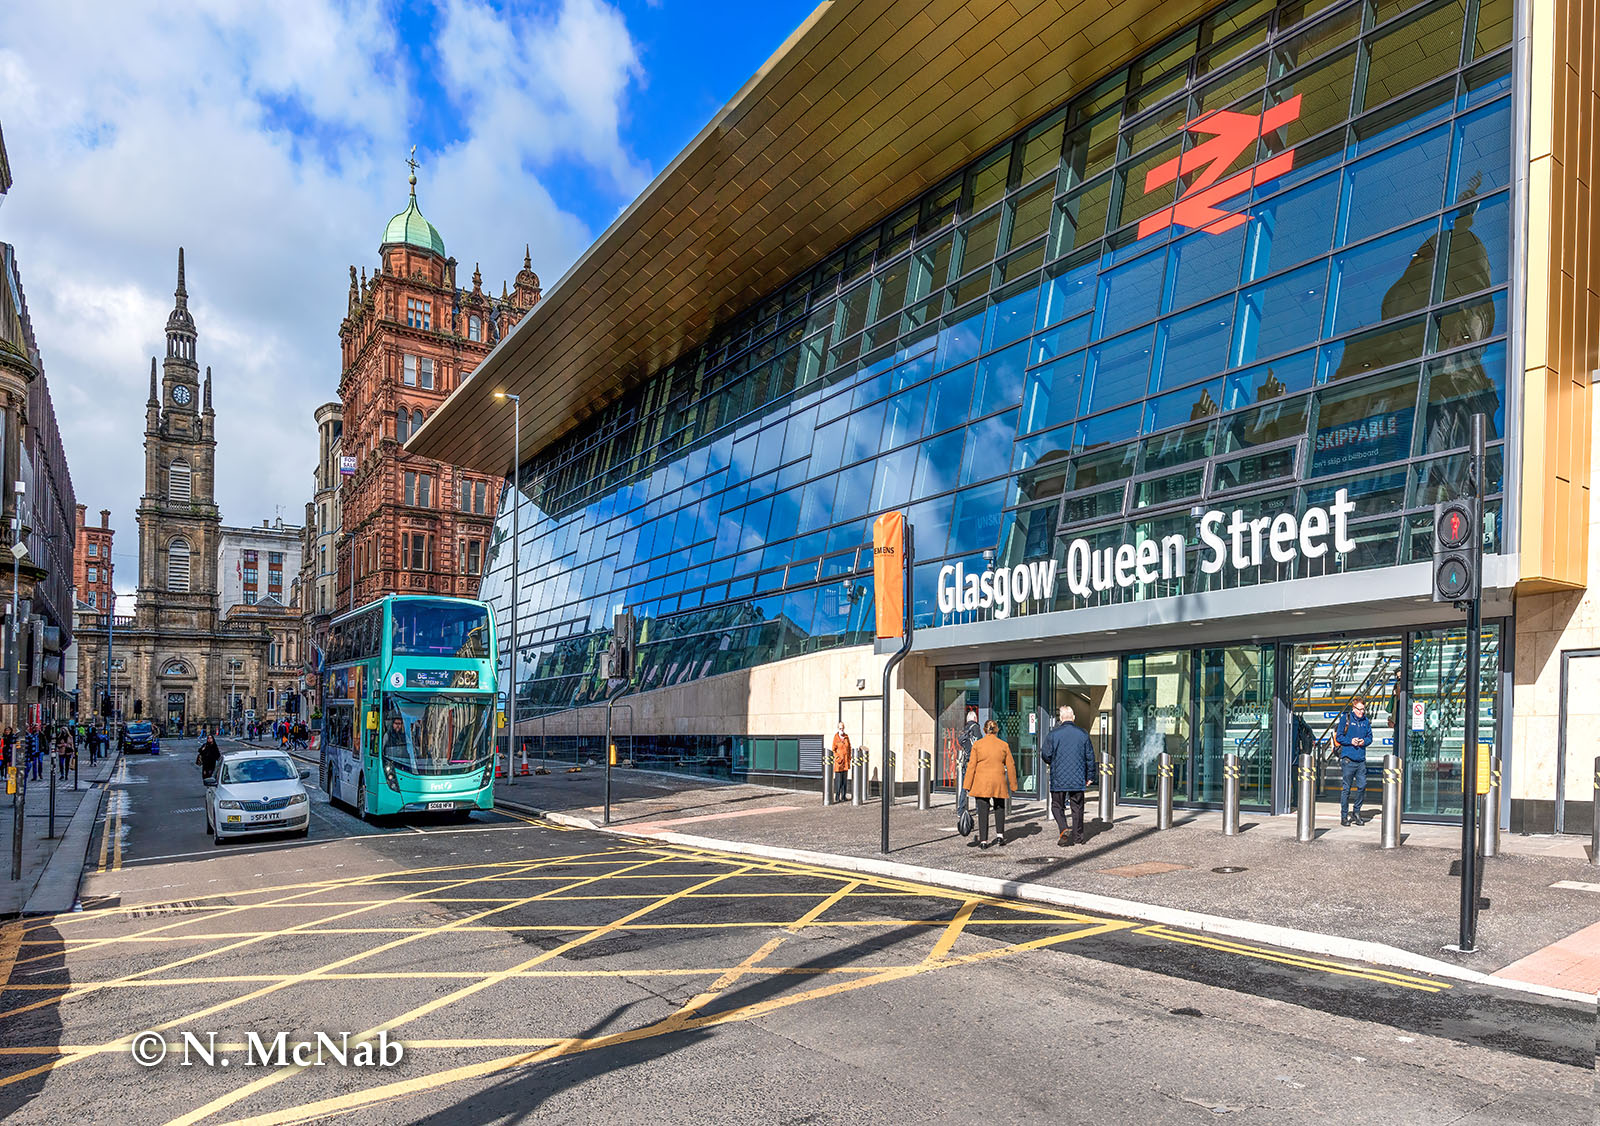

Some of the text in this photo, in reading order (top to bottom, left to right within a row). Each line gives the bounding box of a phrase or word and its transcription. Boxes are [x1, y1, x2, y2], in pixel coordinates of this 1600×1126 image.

[1315, 416, 1398, 451] SKIPPABLE
[1327, 456, 1341, 466] skip
[937, 488, 1357, 620] Glasgow Queen Street
[1225, 701, 1270, 718] ScotRail
